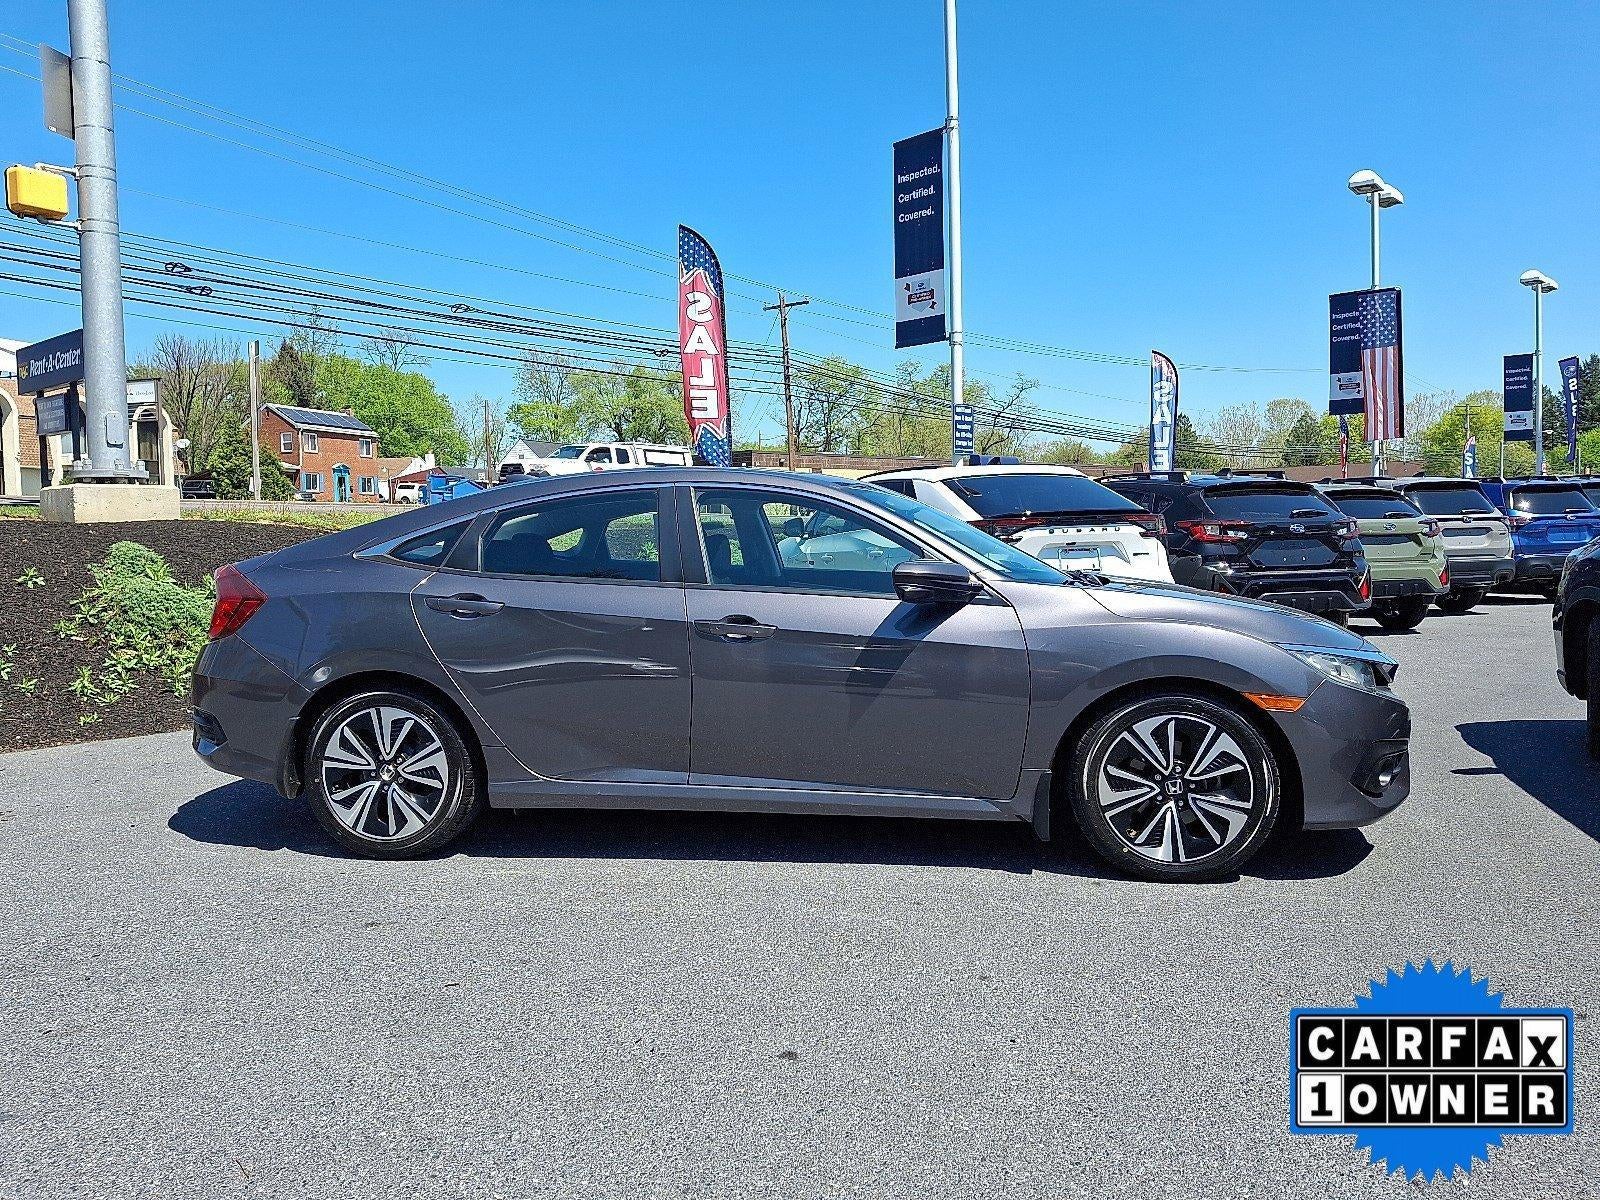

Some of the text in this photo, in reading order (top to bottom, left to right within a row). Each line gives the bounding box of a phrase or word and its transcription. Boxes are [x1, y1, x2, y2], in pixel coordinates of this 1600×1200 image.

[897, 163, 941, 184] Inspected.
[898, 185, 936, 203] Certified.
[898, 205, 935, 223] Covered.
[1332, 311, 1360, 320] Inspecte
